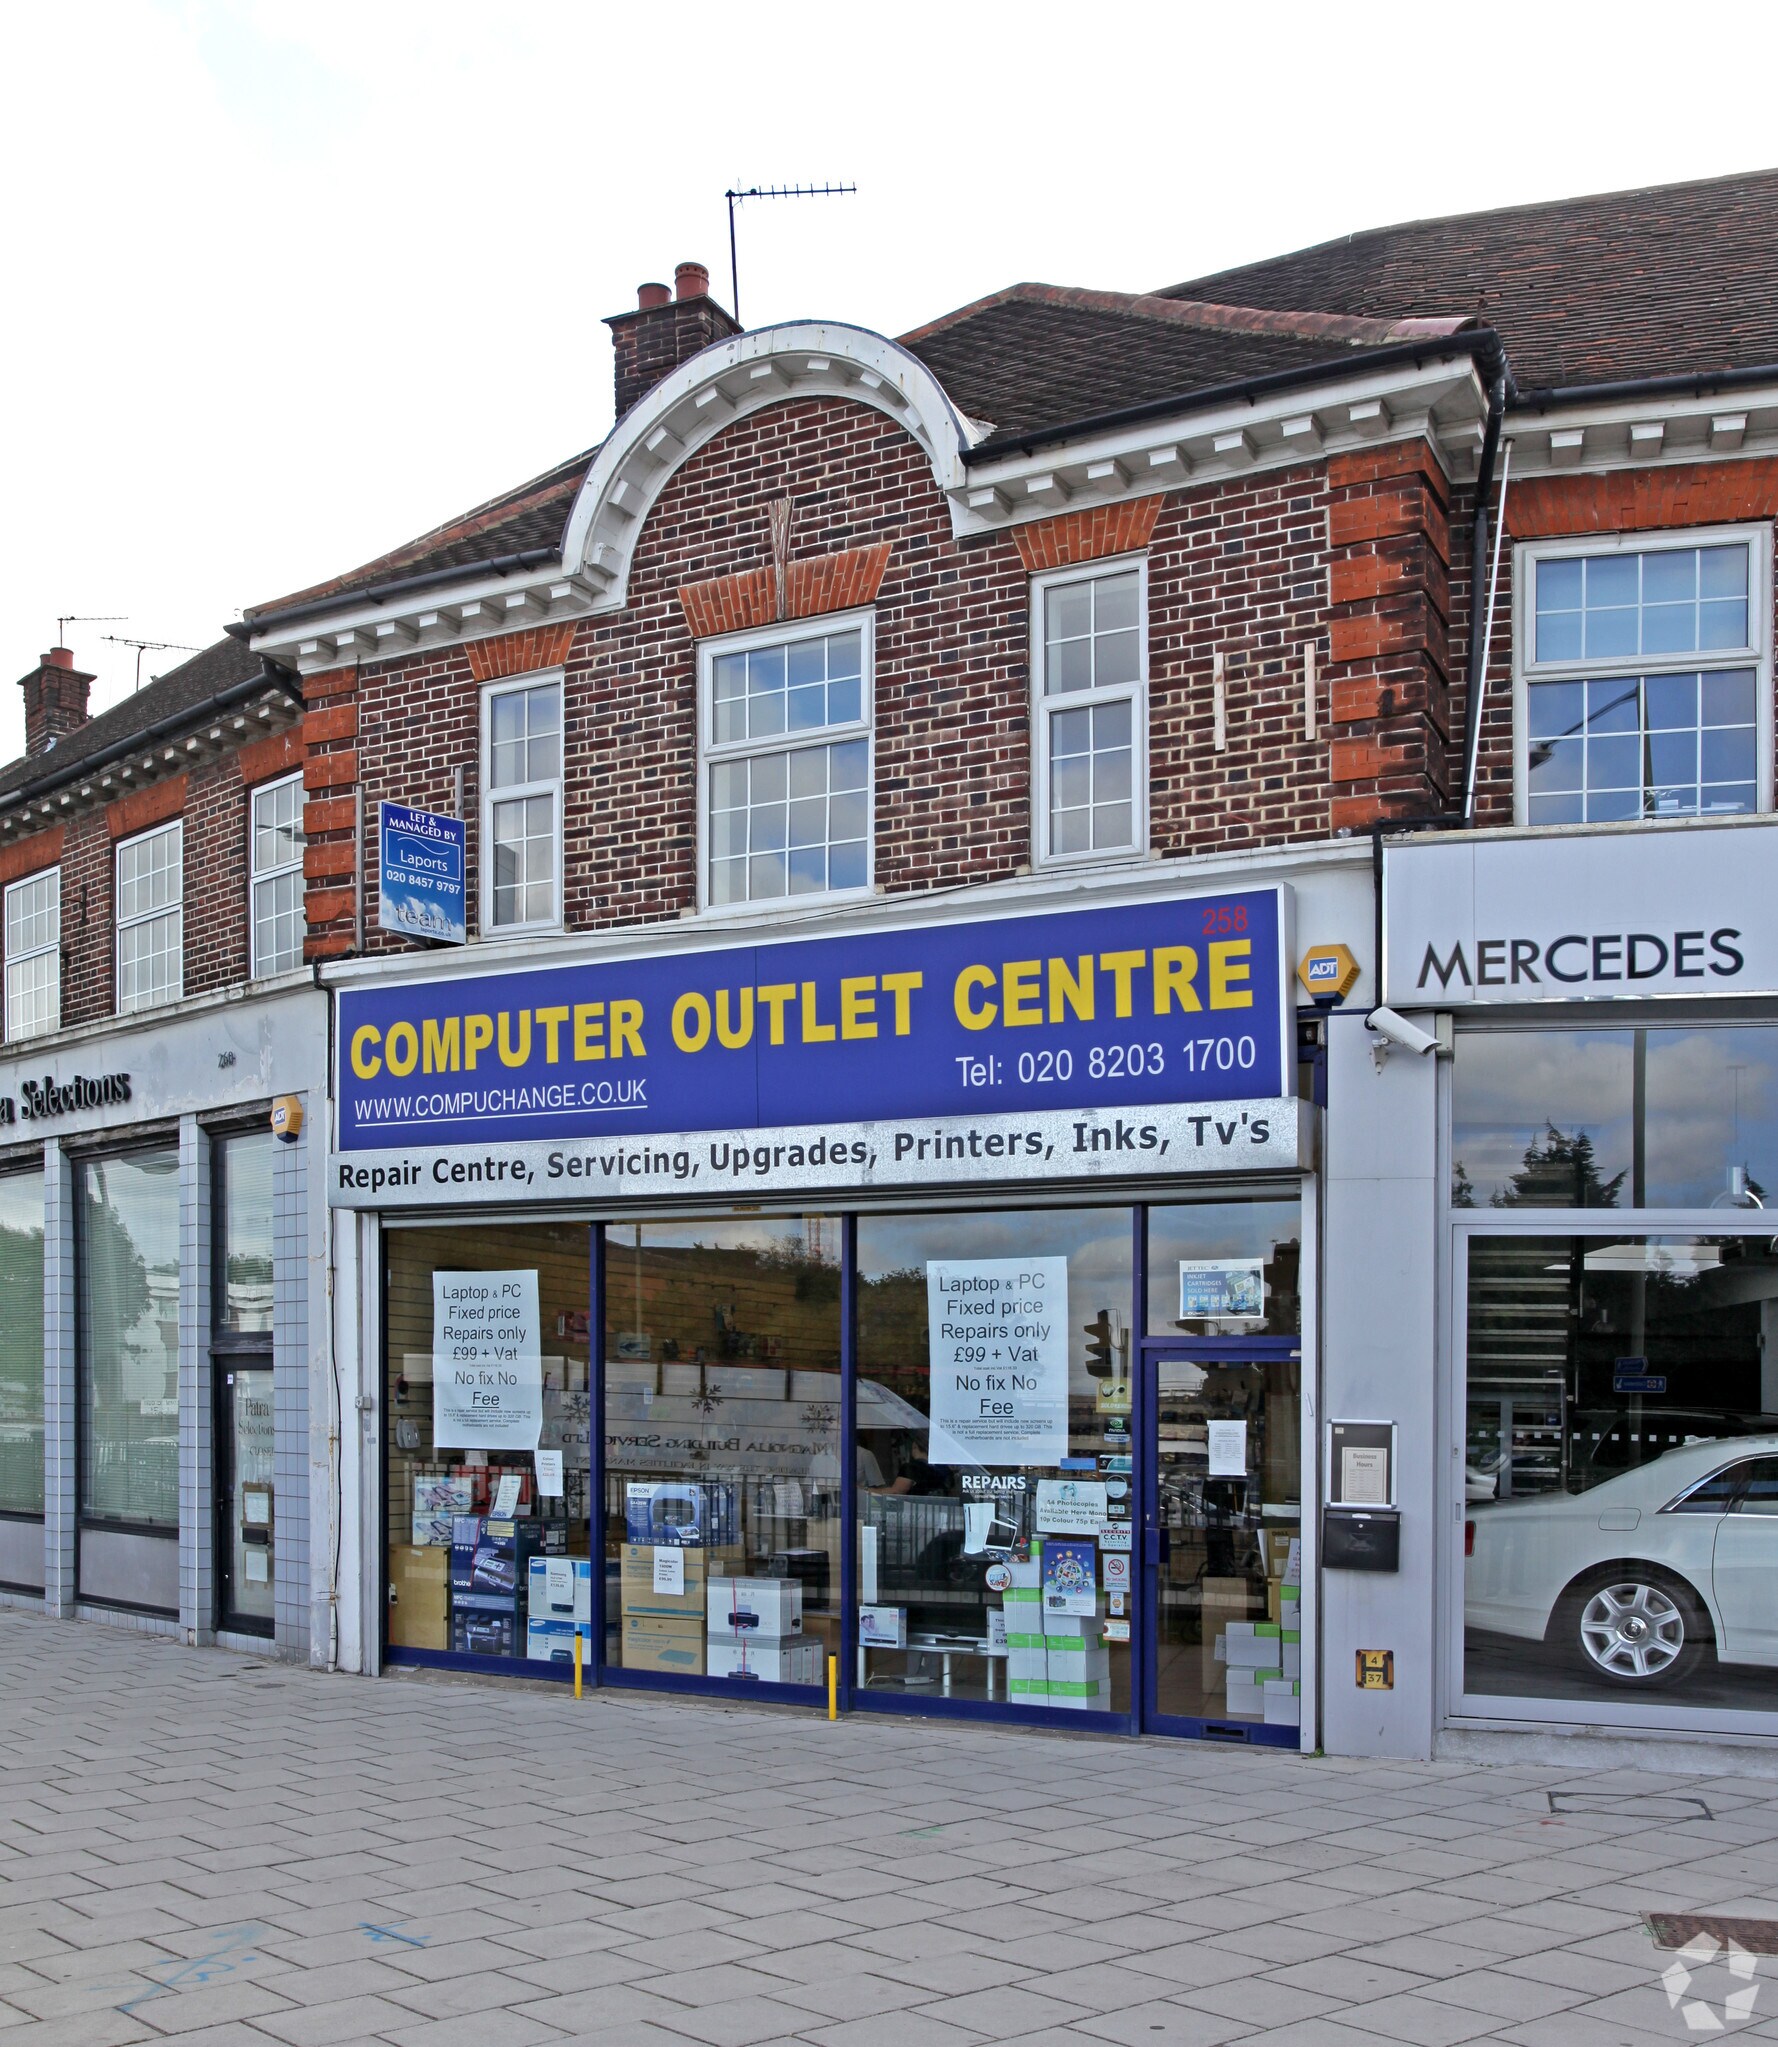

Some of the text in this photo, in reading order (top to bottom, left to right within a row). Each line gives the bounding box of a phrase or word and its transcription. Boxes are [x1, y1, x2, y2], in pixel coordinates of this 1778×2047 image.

[410, 812, 437, 826] LET &
[390, 818, 456, 841] MANAGED BY
[400, 849, 448, 872] Laports
[386, 870, 460, 894] 020 8457 9797
[396, 904, 452, 932] team
[1202, 905, 1248, 936] 258
[1416, 927, 1744, 990] MERCEDES
[1310, 960, 1337, 977] ADT
[351, 938, 1253, 1080] COMPUTER OUTLET CENTRE
[956, 1036, 1256, 1087] Tel: 020 8203 1700
[20, 1072, 132, 1120] Selections
[355, 1078, 647, 1121] WWW.COMPUCHANGE.CO.UK
[274, 1110, 285, 1120] ADT
[339, 1112, 1270, 1193] Repair Centre, Servicing, Upgrades, Printers, Inks, Tv's
[443, 1284, 521, 1302] Laptop & PC
[940, 1273, 1045, 1295] Laptop & PC
[449, 1305, 520, 1322] Fixed price
[947, 1298, 1043, 1318] Fixed price
[444, 1326, 526, 1343] Repairs only
[941, 1322, 1050, 1342] Repairs only
[453, 1346, 518, 1360] £99 + Vat
[954, 1346, 1038, 1362] £99 + Vat
[454, 1371, 517, 1385] No fix No
[956, 1375, 1036, 1390] No fix No
[246, 1398, 270, 1416] Patra
[472, 1392, 500, 1406] Fee
[980, 1399, 1013, 1414] Fee
[962, 1476, 1026, 1489] REPAIRS
[1371, 1656, 1377, 1664] 4
[1368, 1674, 1381, 1682] 37
